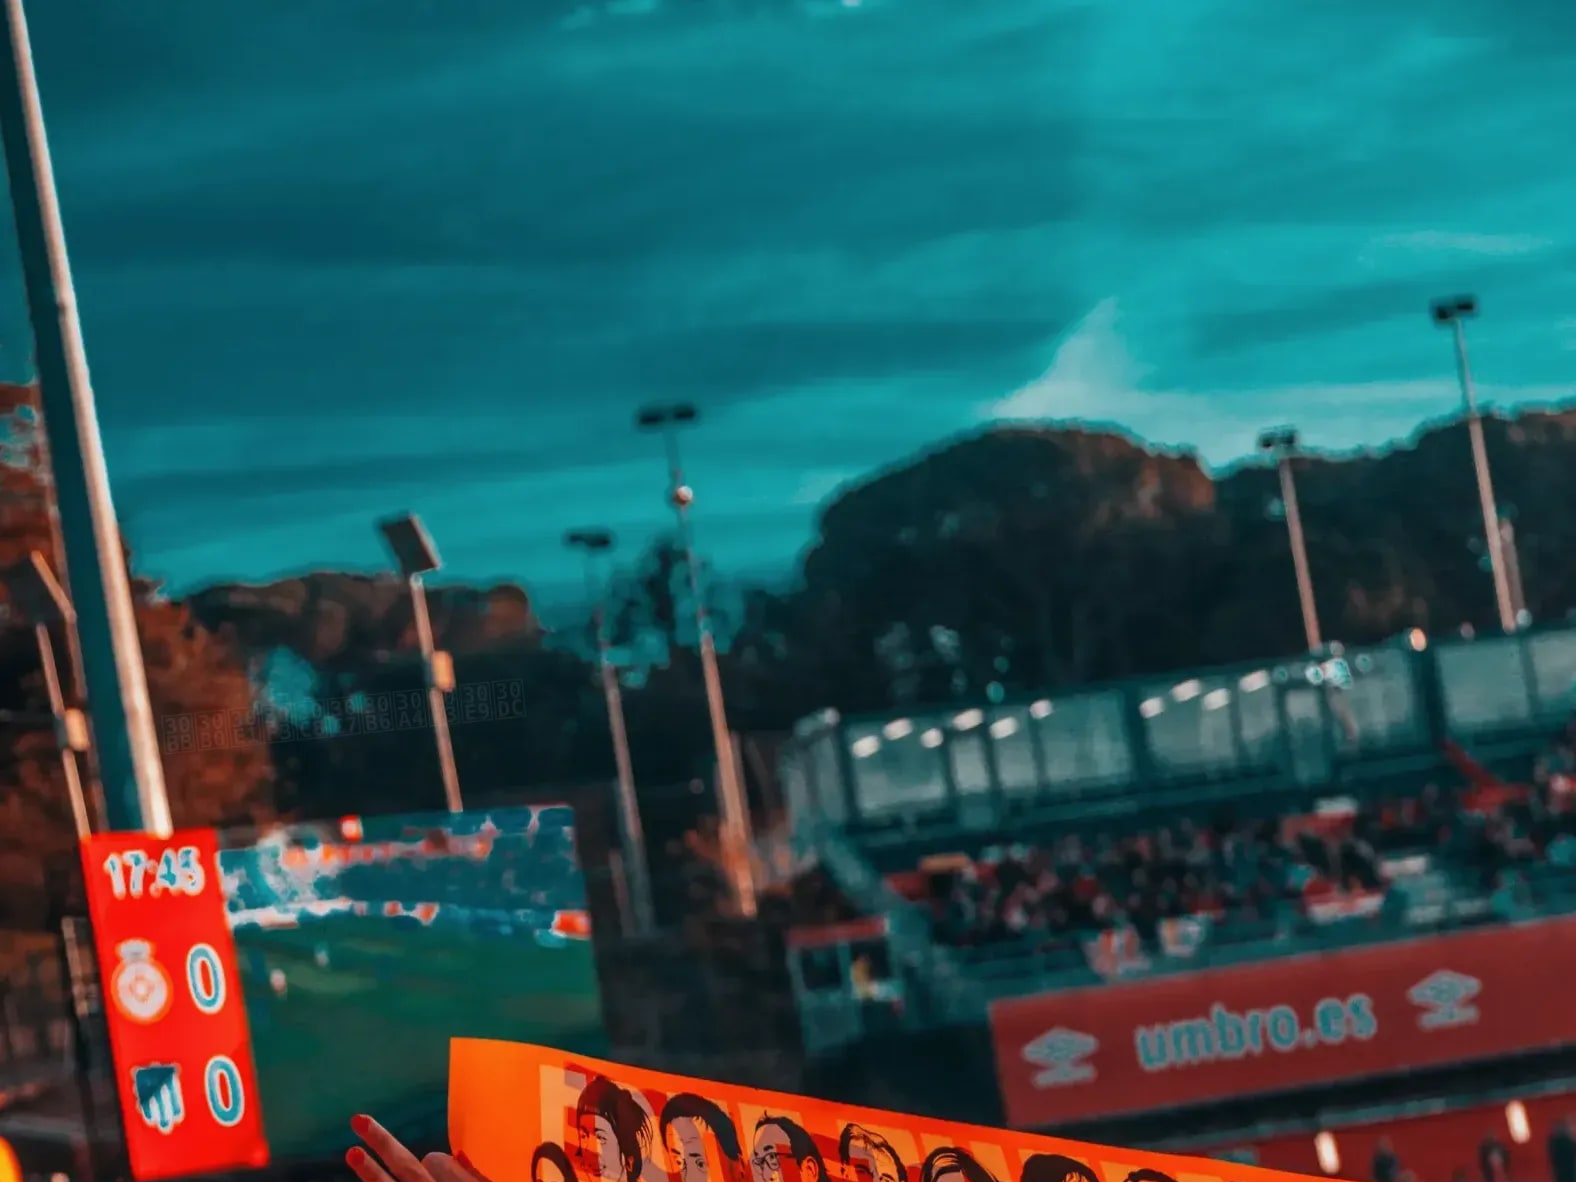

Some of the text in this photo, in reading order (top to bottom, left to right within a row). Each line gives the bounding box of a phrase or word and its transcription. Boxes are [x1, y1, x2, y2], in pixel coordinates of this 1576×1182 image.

[186, 943, 226, 1014] 0
[1134, 994, 1377, 1071] umbro.es
[205, 1055, 244, 1126] 0
